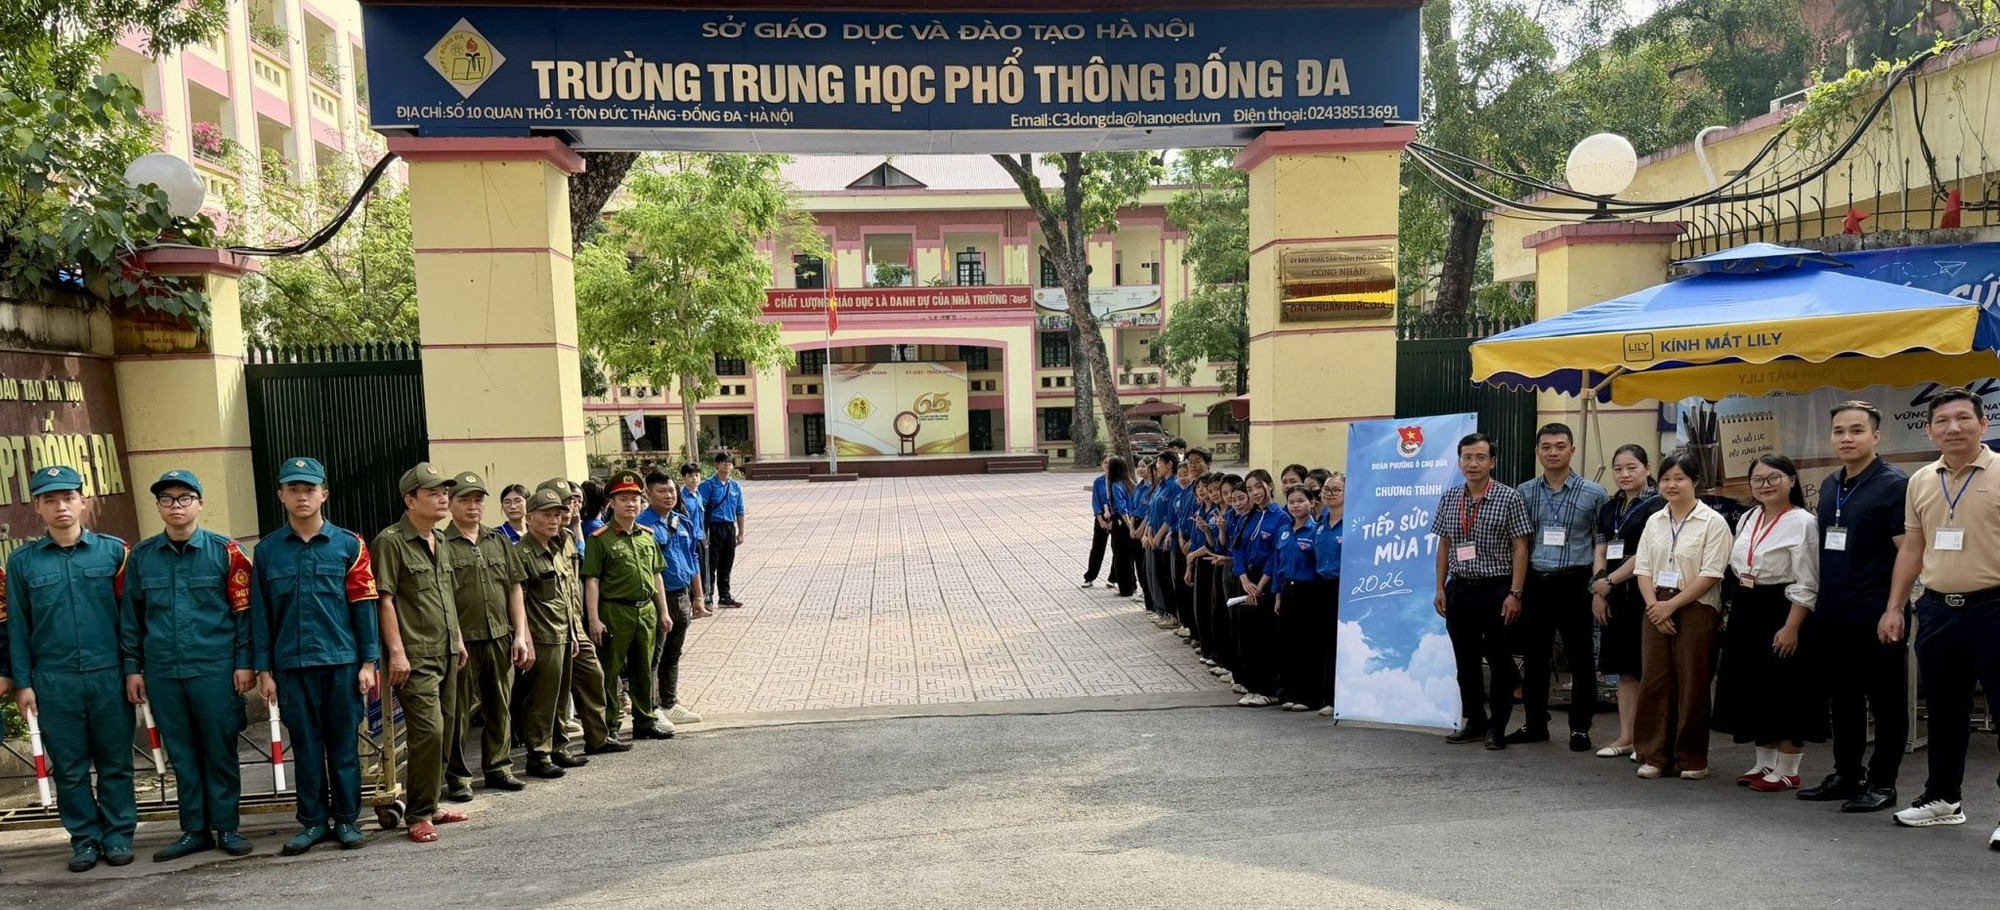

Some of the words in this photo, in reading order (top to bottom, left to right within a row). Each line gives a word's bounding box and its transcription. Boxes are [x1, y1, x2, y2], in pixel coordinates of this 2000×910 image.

[702, 15, 747, 38] SỞ
[754, 17, 827, 39] GIÁO
[843, 23, 904, 44] DỤC
[911, 20, 950, 40] VÀ
[957, 20, 1022, 40] ĐÀO
[1028, 24, 1085, 44] TẠO
[1096, 18, 1138, 39] HÀ
[1144, 17, 1195, 42] NỘI
[531, 50, 701, 102] TRƯỜNG
[707, 63, 845, 104] TRUNG
[854, 64, 936, 112] HỌC
[944, 46, 1025, 105] PHỔ
[1033, 55, 1166, 103] THÔNG
[1174, 46, 1283, 101] ĐỐNG
[1296, 58, 1351, 97] ĐA
[396, 106, 420, 121] ĐỊA
[467, 107, 481, 119] 10
[484, 107, 523, 121] QUAN
[555, 108, 563, 119] 1
[600, 104, 629, 120] ĐỨC
[723, 110, 743, 122] ĐA
[750, 106, 769, 123] HÀ
[770, 108, 794, 126] NỘI
[1233, 108, 1266, 124] Điện
[774, 293, 798, 309] CHẤT
[855, 296, 874, 309] DỤC
[876, 294, 888, 307] LÀ
[890, 295, 915, 307] DANH
[917, 295, 931, 309] DỰ
[932, 291, 950, 306] CỦA
[951, 292, 970, 305] NHÀ
[972, 291, 1007, 305] TRƯỜNG
[1628, 341, 1650, 352] LILY
[1660, 337, 1700, 353] KÍNH
[1705, 331, 1742, 350] MẮT
[1747, 331, 1783, 348] LILY
[46, 374, 62, 401] HÀ
[912, 391, 952, 415] 65
[0, 435, 31, 506] PT
[91, 433, 126, 497] ĐA
[1371, 462, 1388, 470] ĐOÀN
[1375, 485, 1412, 498] CHƯƠNG
[1415, 483, 1442, 496] TRÌNH
[1362, 511, 1395, 541] TIẾP
[1399, 506, 1429, 532] SỨC
[1374, 534, 1419, 567] MÙA
[1351, 570, 1405, 595] 2026
